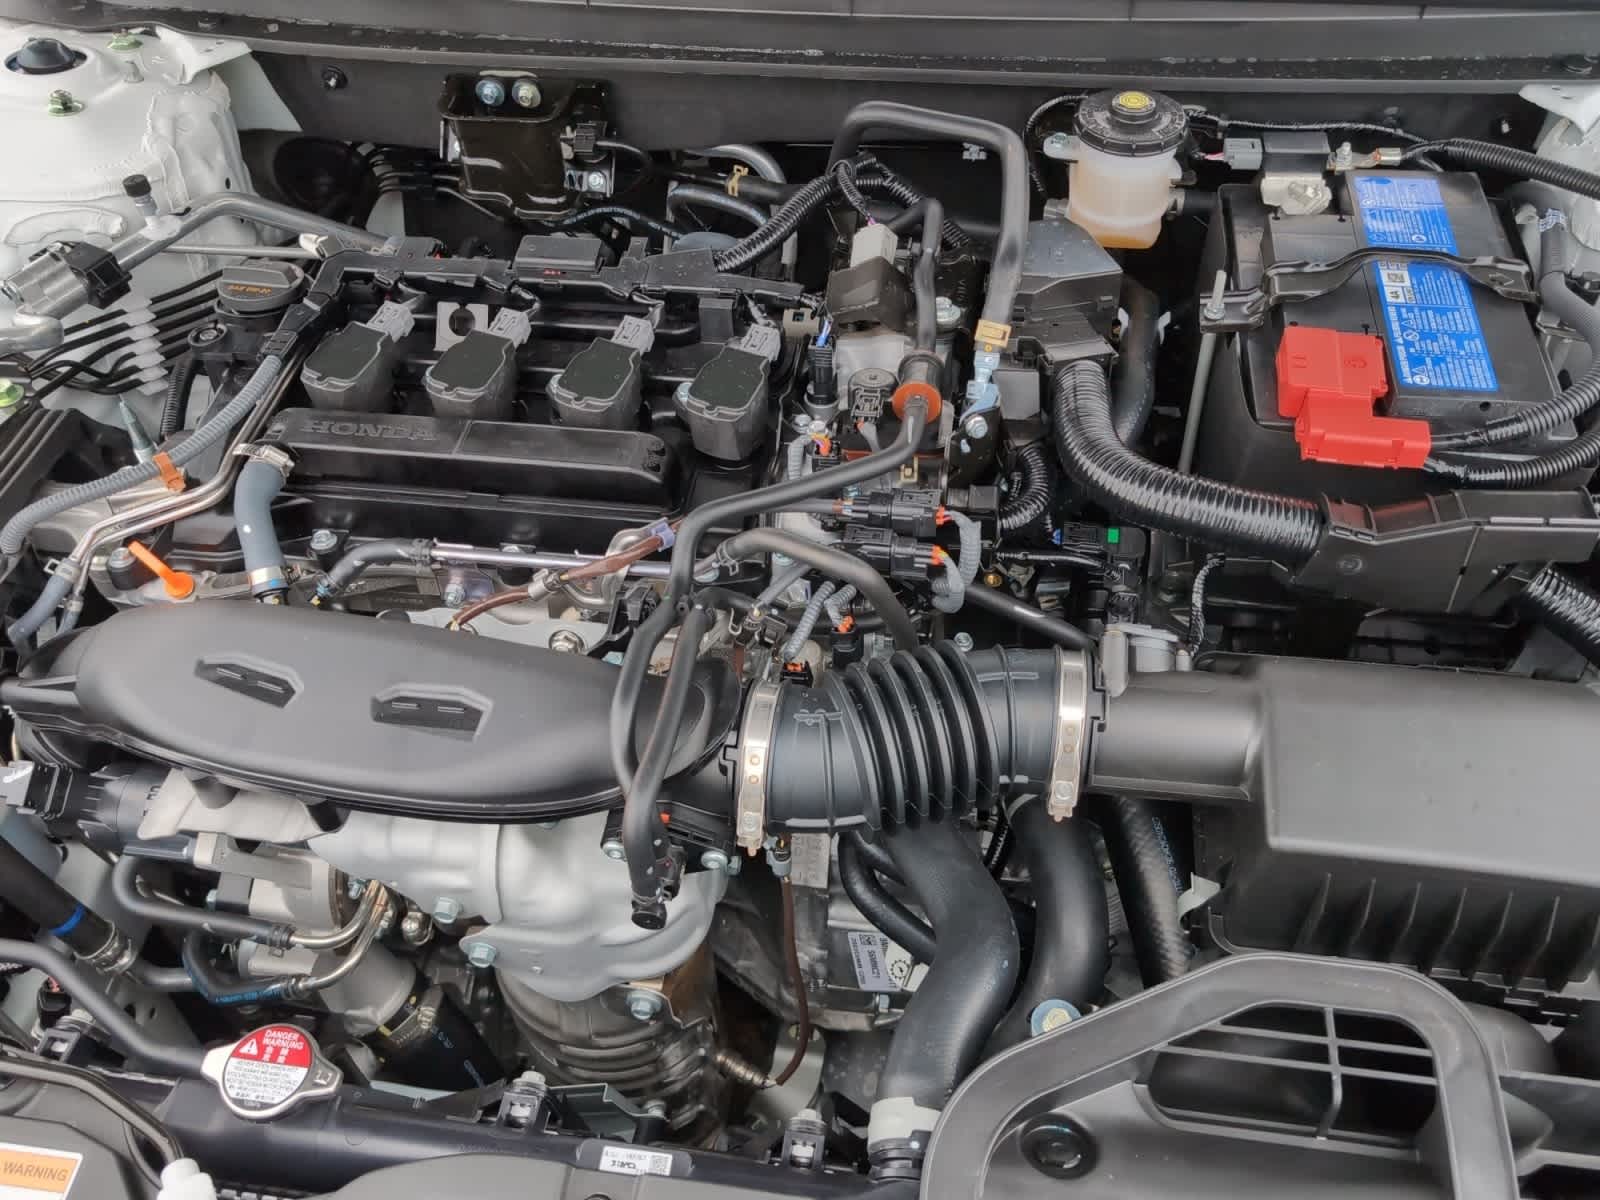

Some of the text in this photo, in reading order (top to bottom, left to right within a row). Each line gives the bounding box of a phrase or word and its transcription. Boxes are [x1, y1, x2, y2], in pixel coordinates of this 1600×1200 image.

[300, 419, 440, 441] HONDA
[264, 1029, 300, 1040] DANGER
[3, 1160, 69, 1182] WARNING
